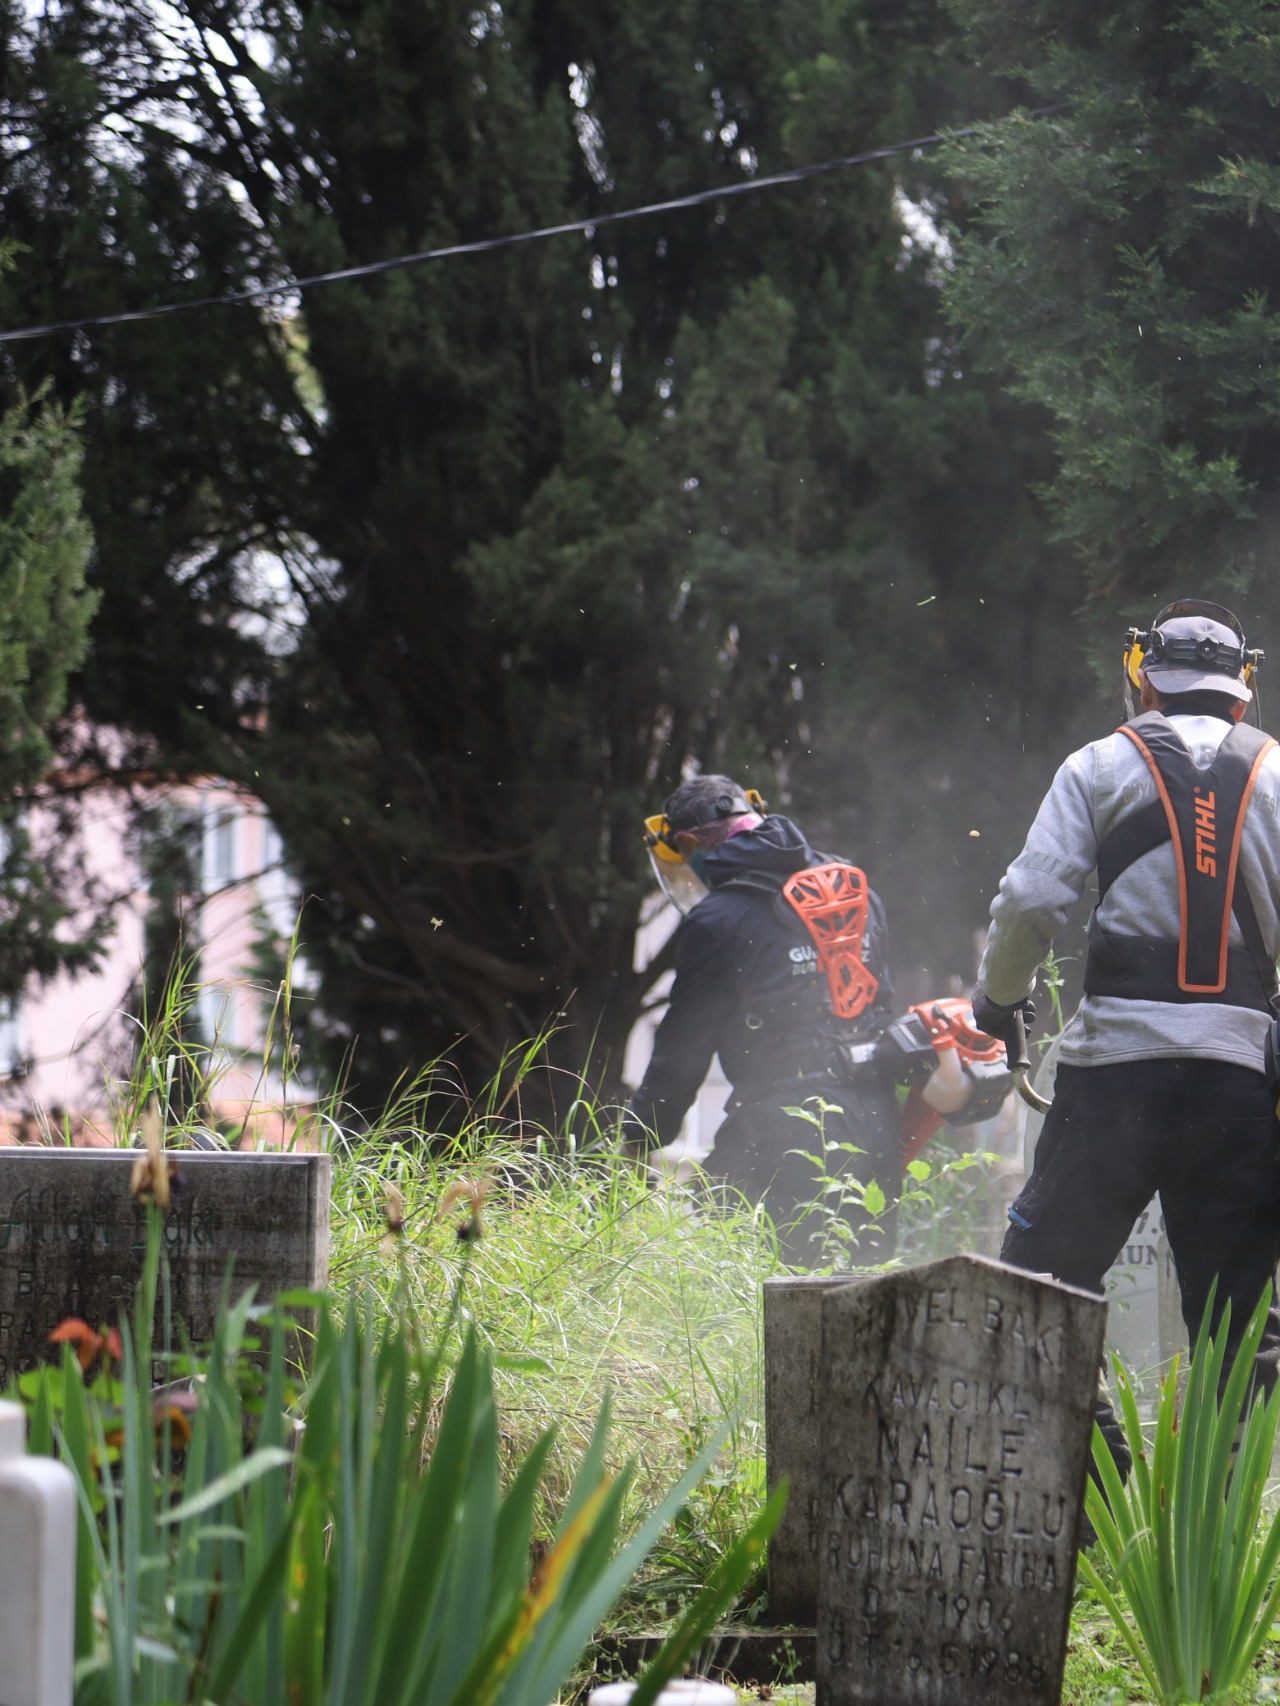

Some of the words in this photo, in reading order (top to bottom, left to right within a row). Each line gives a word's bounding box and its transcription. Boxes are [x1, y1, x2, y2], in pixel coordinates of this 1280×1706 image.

[1194, 791, 1217, 878] STIHL
[826, 1474, 1066, 1540] KARAOĞLU
[826, 1533, 943, 1580] RUHUNA
